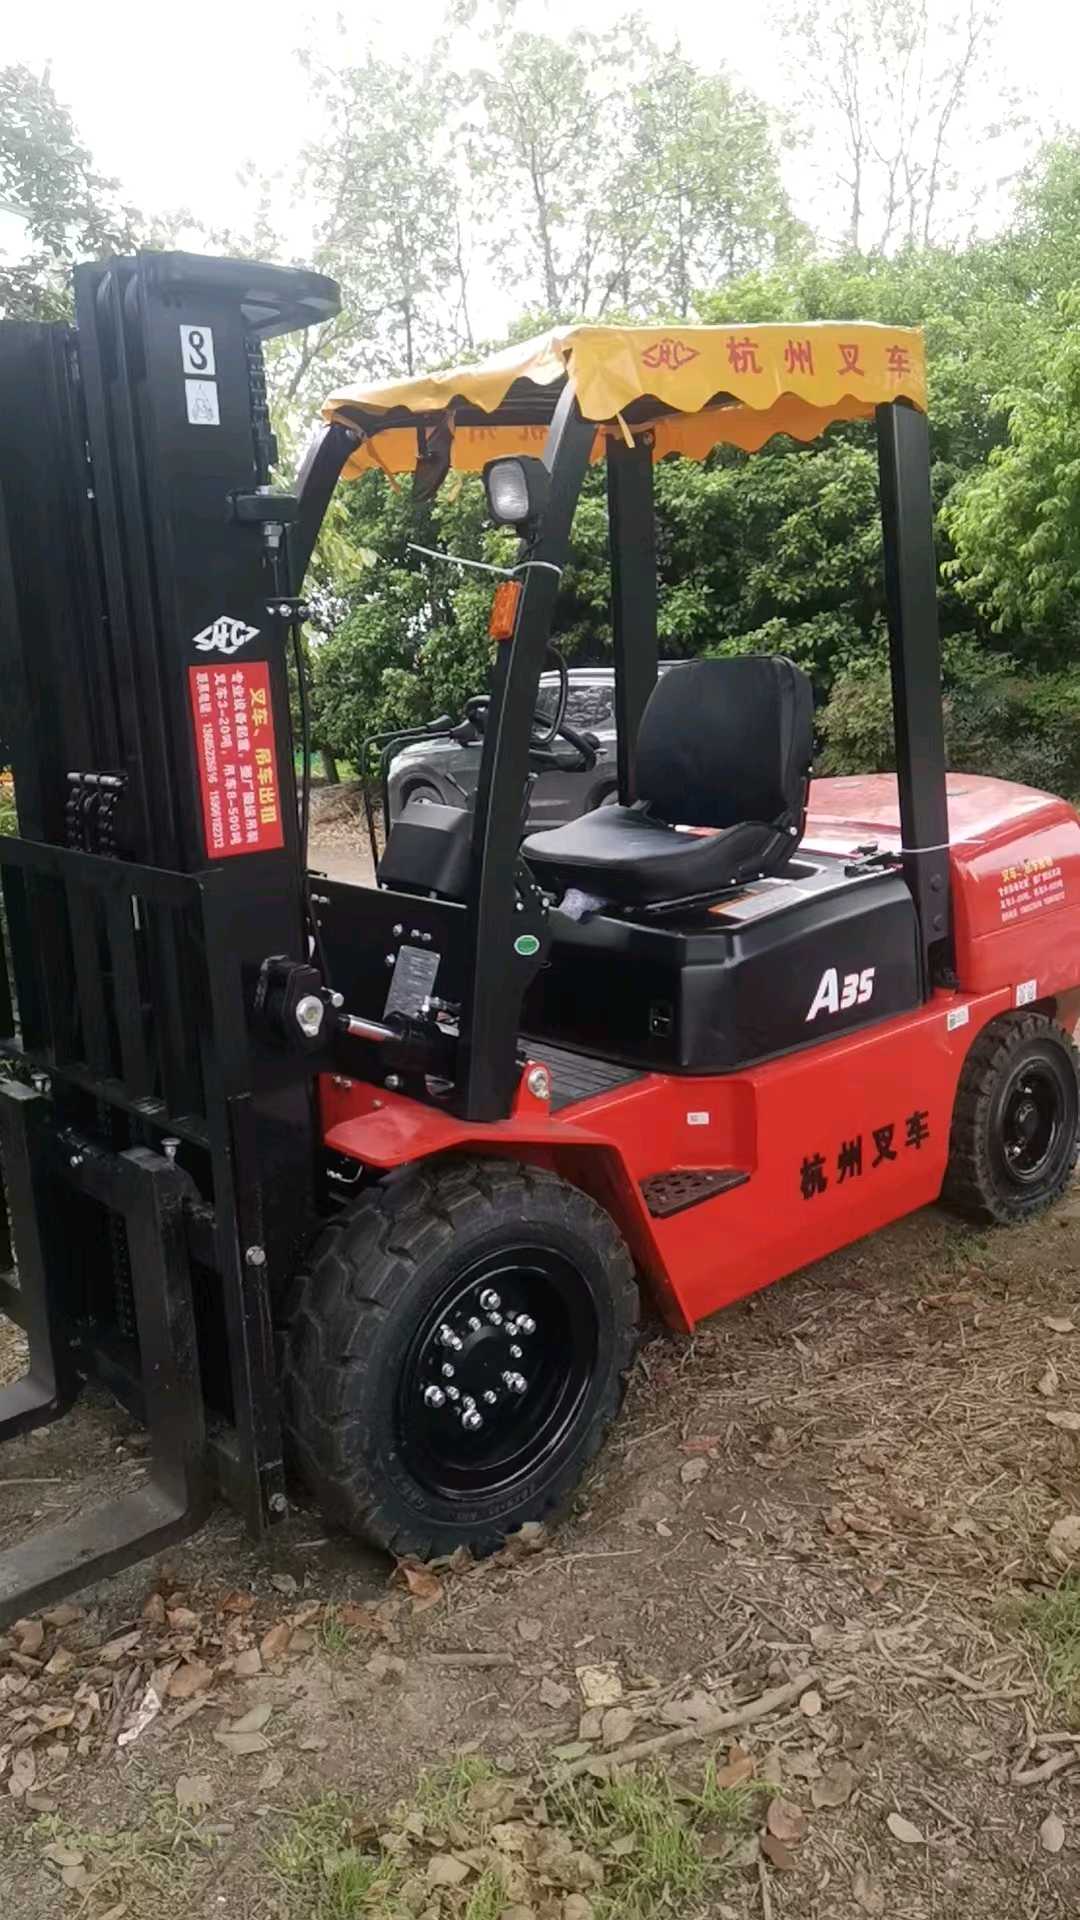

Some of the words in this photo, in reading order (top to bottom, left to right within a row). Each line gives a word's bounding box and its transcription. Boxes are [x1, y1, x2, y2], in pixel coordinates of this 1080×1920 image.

[726, 336, 911, 379] 杭州叉车
[248, 686, 277, 824] 叉车、吊车出租
[805, 967, 876, 1022] A35
[800, 1110, 931, 1200] 杭州叉车
